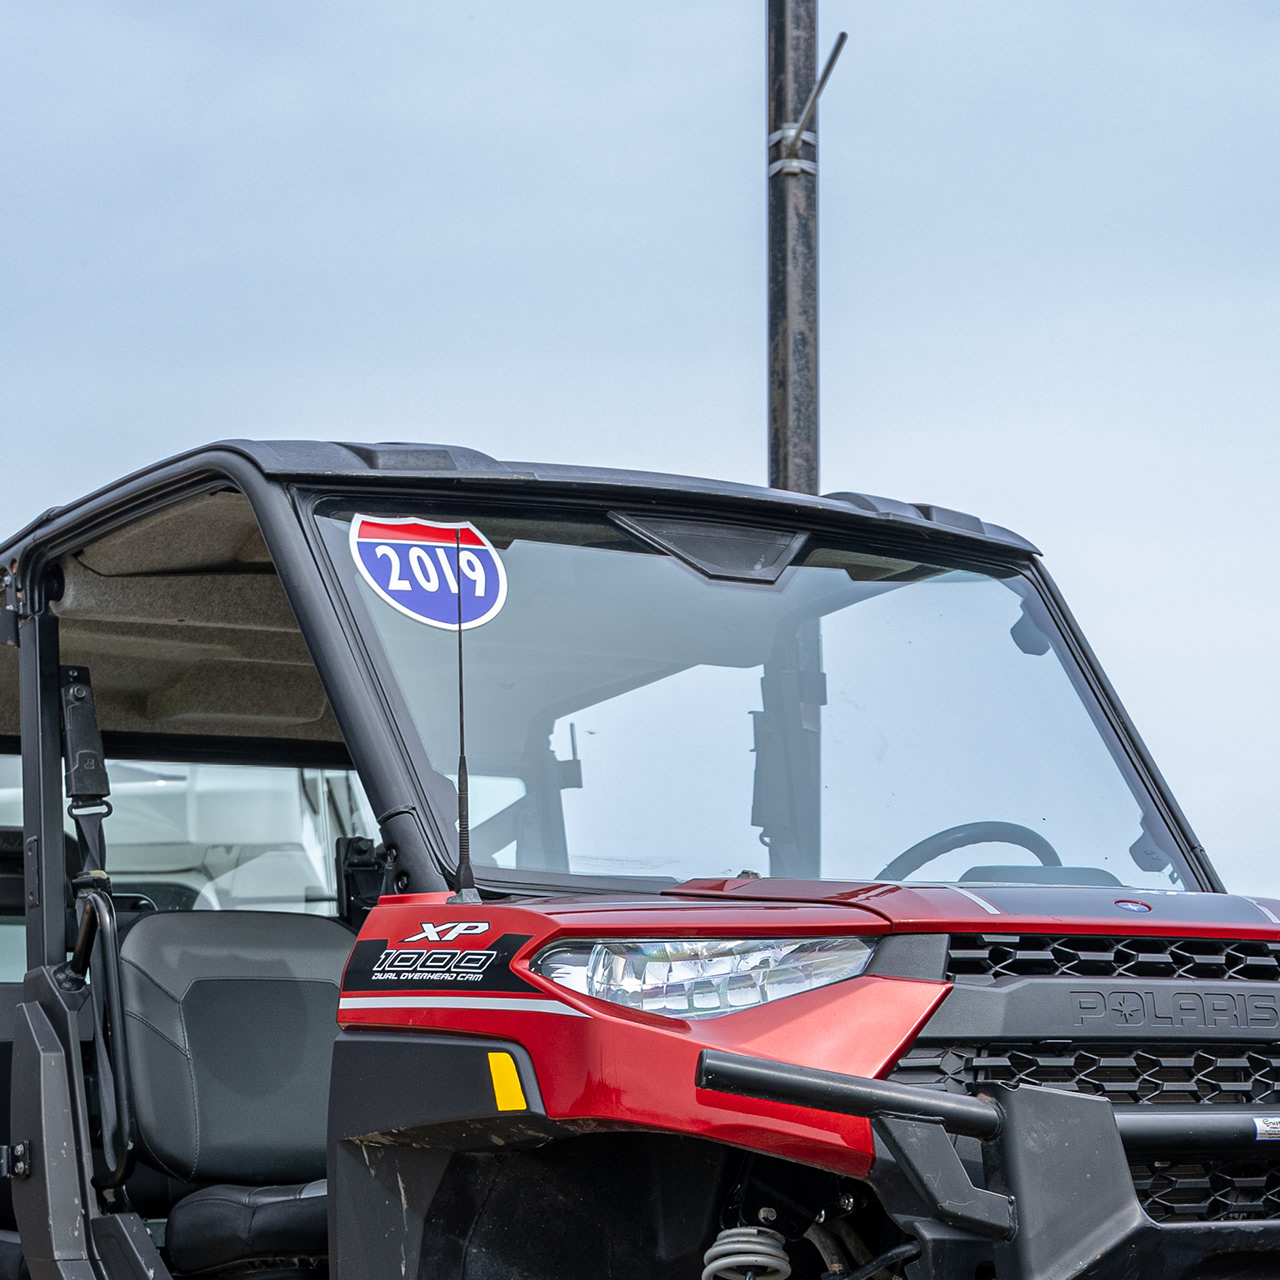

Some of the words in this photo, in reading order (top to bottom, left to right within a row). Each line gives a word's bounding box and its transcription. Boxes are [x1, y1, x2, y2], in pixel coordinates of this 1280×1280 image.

[374, 545, 486, 597] 2019
[398, 921, 490, 943] XP
[372, 949, 497, 973] 1000
[371, 972, 398, 980] DUAL
[401, 972, 457, 981] OVERHEAD
[456, 973, 484, 982] CAM
[1070, 989, 1280, 1030] POLARIS
